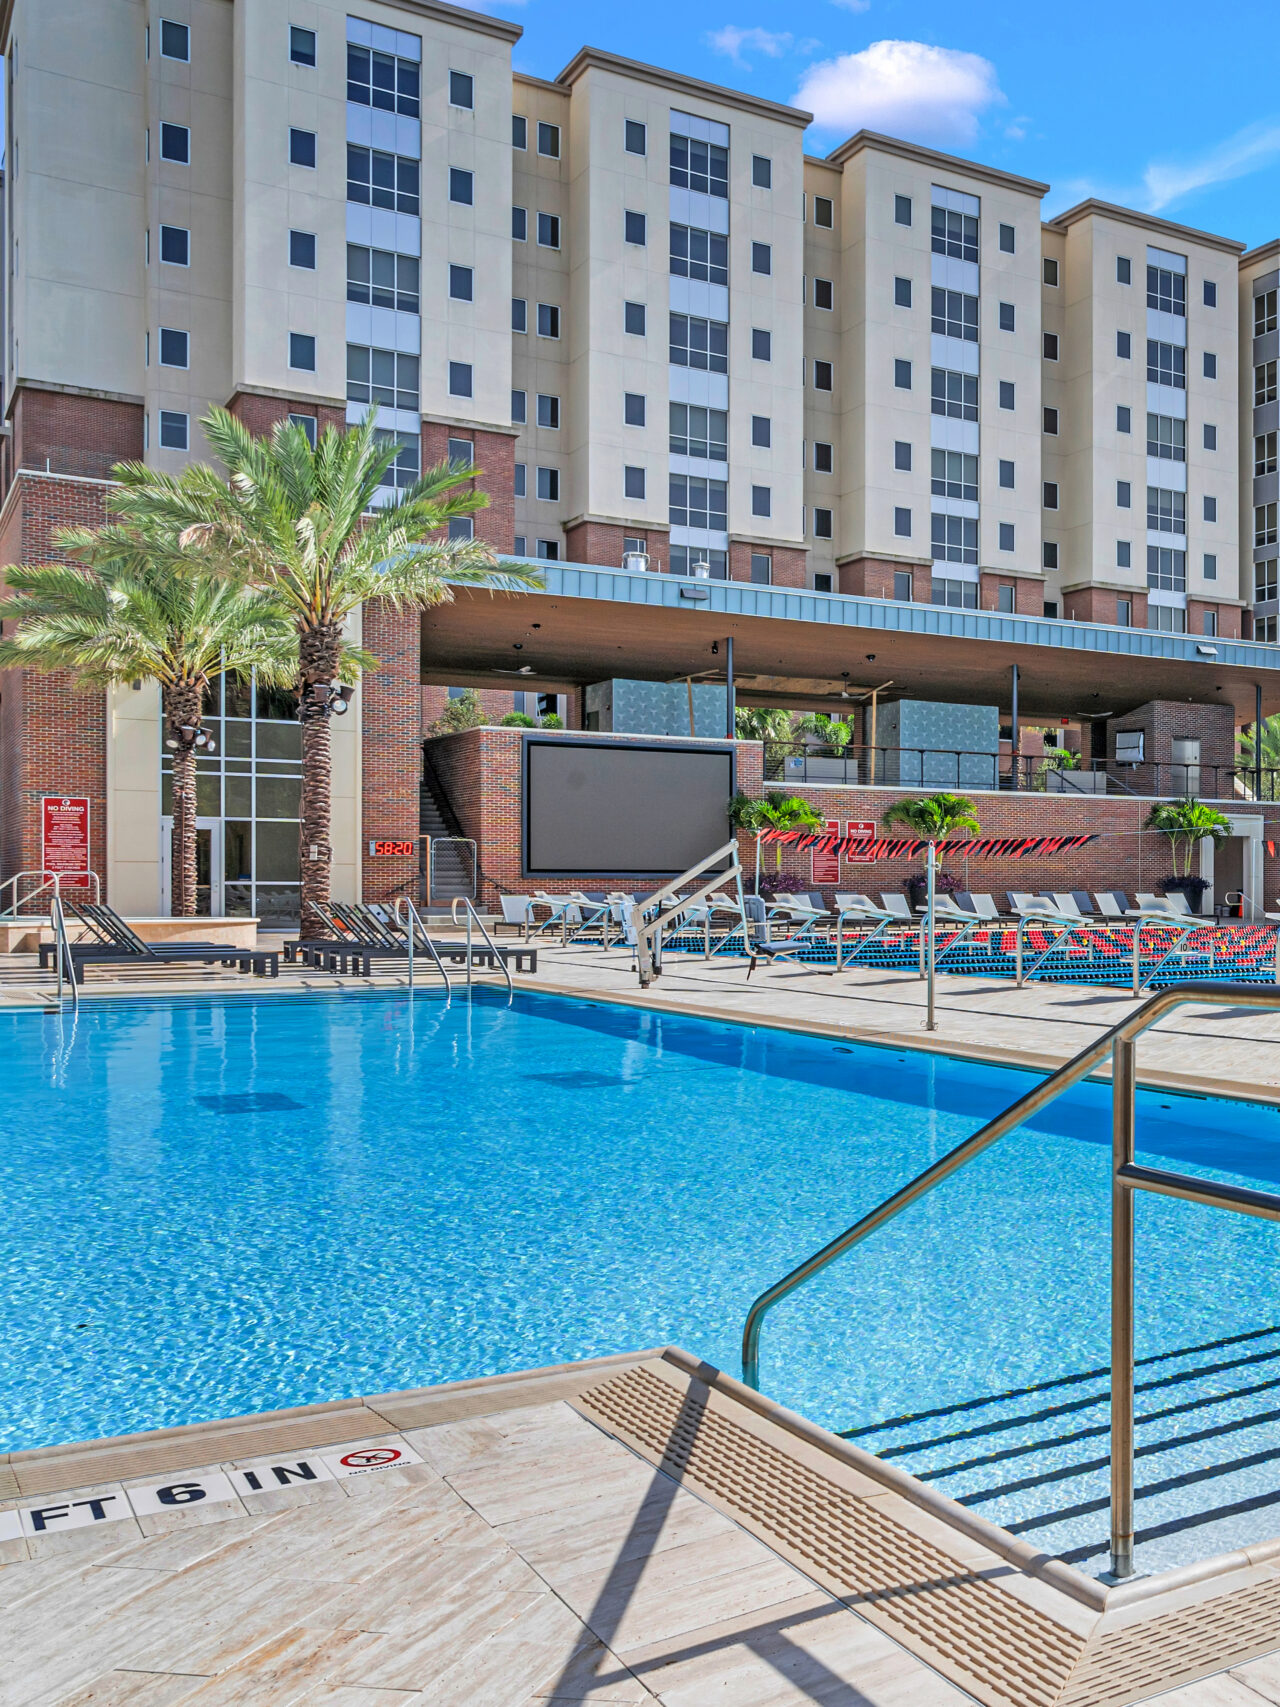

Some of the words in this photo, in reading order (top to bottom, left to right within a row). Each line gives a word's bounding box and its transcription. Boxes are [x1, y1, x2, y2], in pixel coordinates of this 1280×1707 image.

[375, 841, 413, 856] 58:20
[1180, 943, 1188, 952] 10
[348, 1468, 367, 1476] NO
[370, 1461, 412, 1471] DIVING
[30, 1495, 117, 1531] FT
[155, 1482, 207, 1505] 6
[242, 1461, 318, 1491] IN
